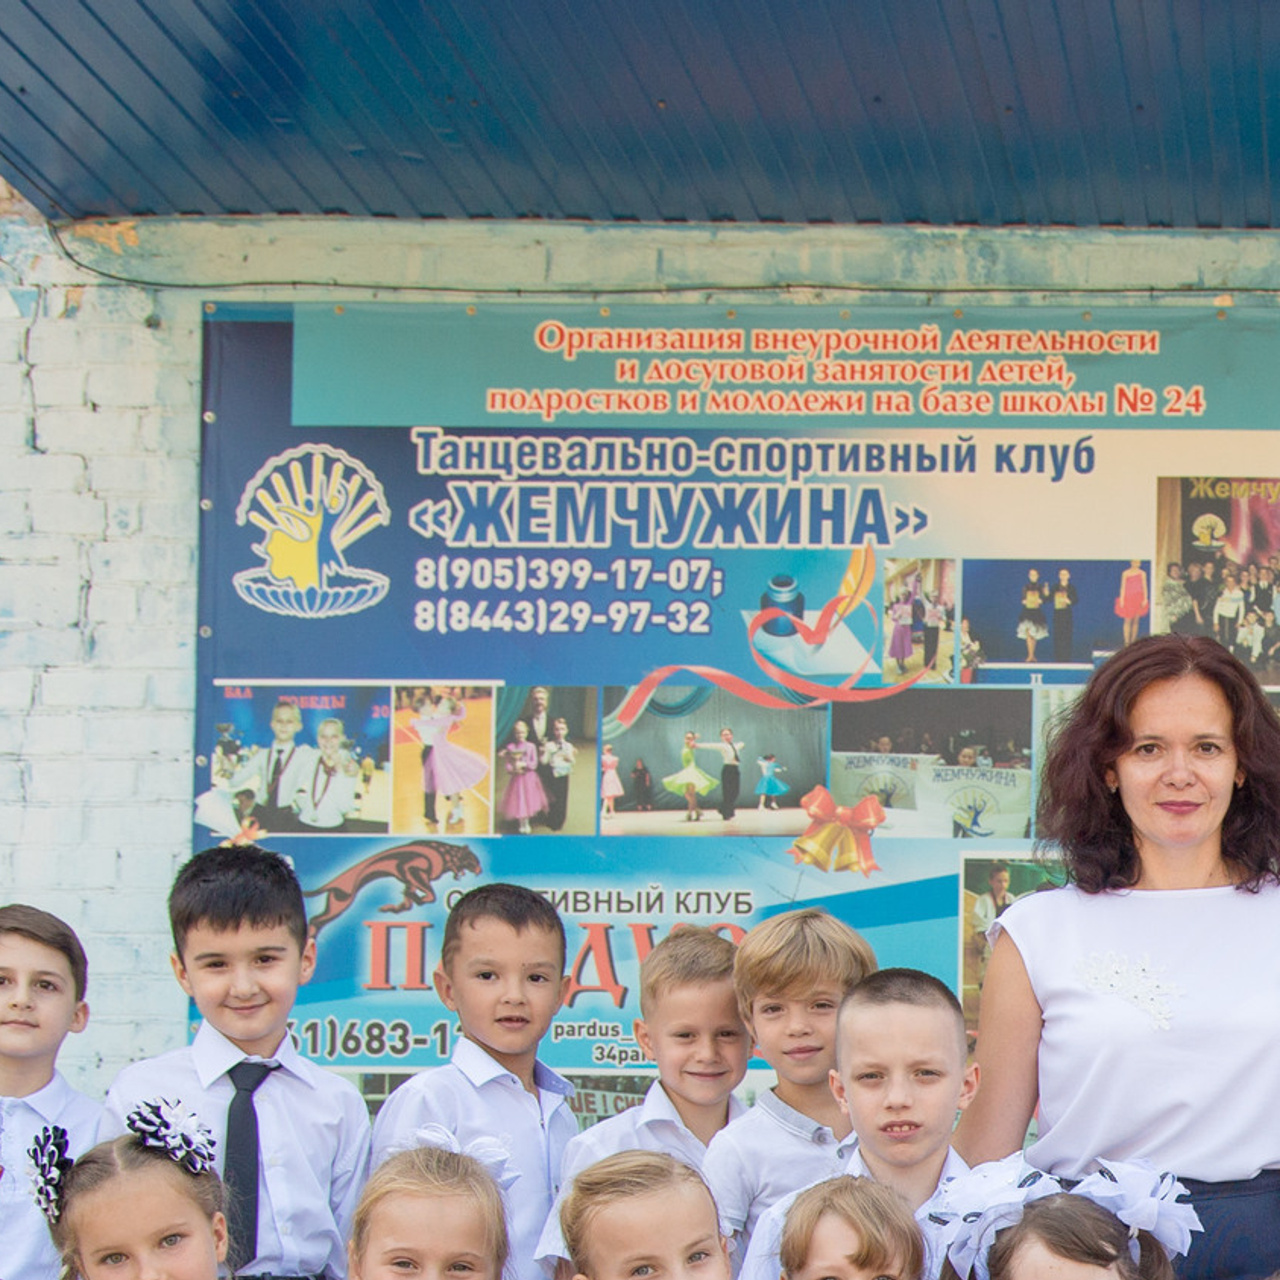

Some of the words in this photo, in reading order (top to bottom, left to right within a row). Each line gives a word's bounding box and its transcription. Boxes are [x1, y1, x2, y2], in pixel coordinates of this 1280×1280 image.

[536, 321, 743, 360] Организация
[752, 325, 940, 359] внеурочной
[947, 330, 1159, 353] деятельности
[616, 359, 639, 382] и
[645, 355, 806, 391] досуговой
[813, 359, 971, 383] занятости
[977, 357, 1076, 389] детей,
[487, 388, 670, 421] подростков
[678, 389, 699, 413] и
[705, 388, 863, 414] молодежи
[873, 391, 914, 414] на
[918, 386, 994, 414] базе
[1000, 391, 1106, 414] школы
[1115, 383, 1156, 414] №
[1164, 384, 1204, 415] 24
[412, 427, 977, 482] Танцевально-спортивный
[995, 435, 1095, 483] клуб
[411, 483, 929, 547] «ЖЕМЧУЖИНА»
[415, 555, 724, 598] 8(905)399-17-07;
[414, 597, 711, 635] 8(8443)29-97-32
[932, 768, 1017, 787] ЖЕМЧУЖИНА
[675, 890, 753, 914] КЛУБ
